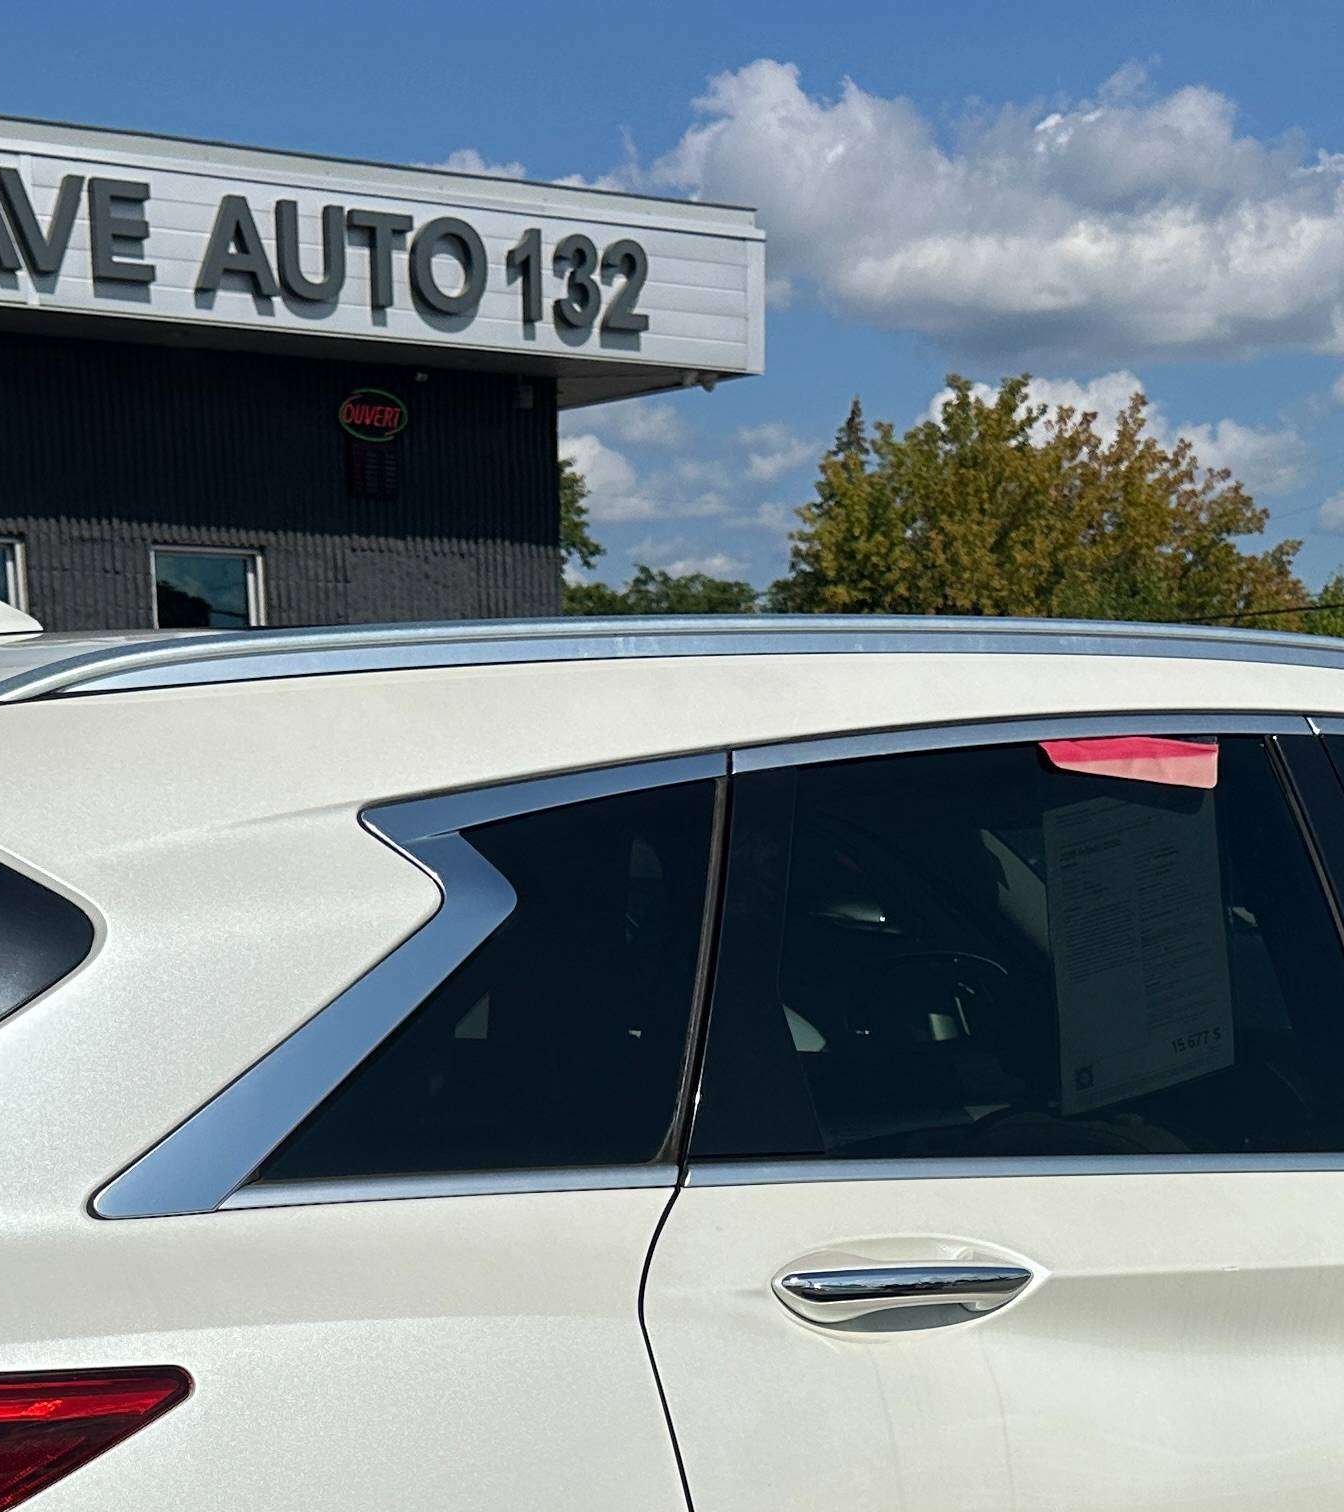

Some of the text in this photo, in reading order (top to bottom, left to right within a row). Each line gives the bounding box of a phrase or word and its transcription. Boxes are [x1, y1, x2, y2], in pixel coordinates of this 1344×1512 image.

[195, 194, 489, 317] AUTO
[505, 227, 650, 333] 132
[344, 403, 401, 427] OUVERT
